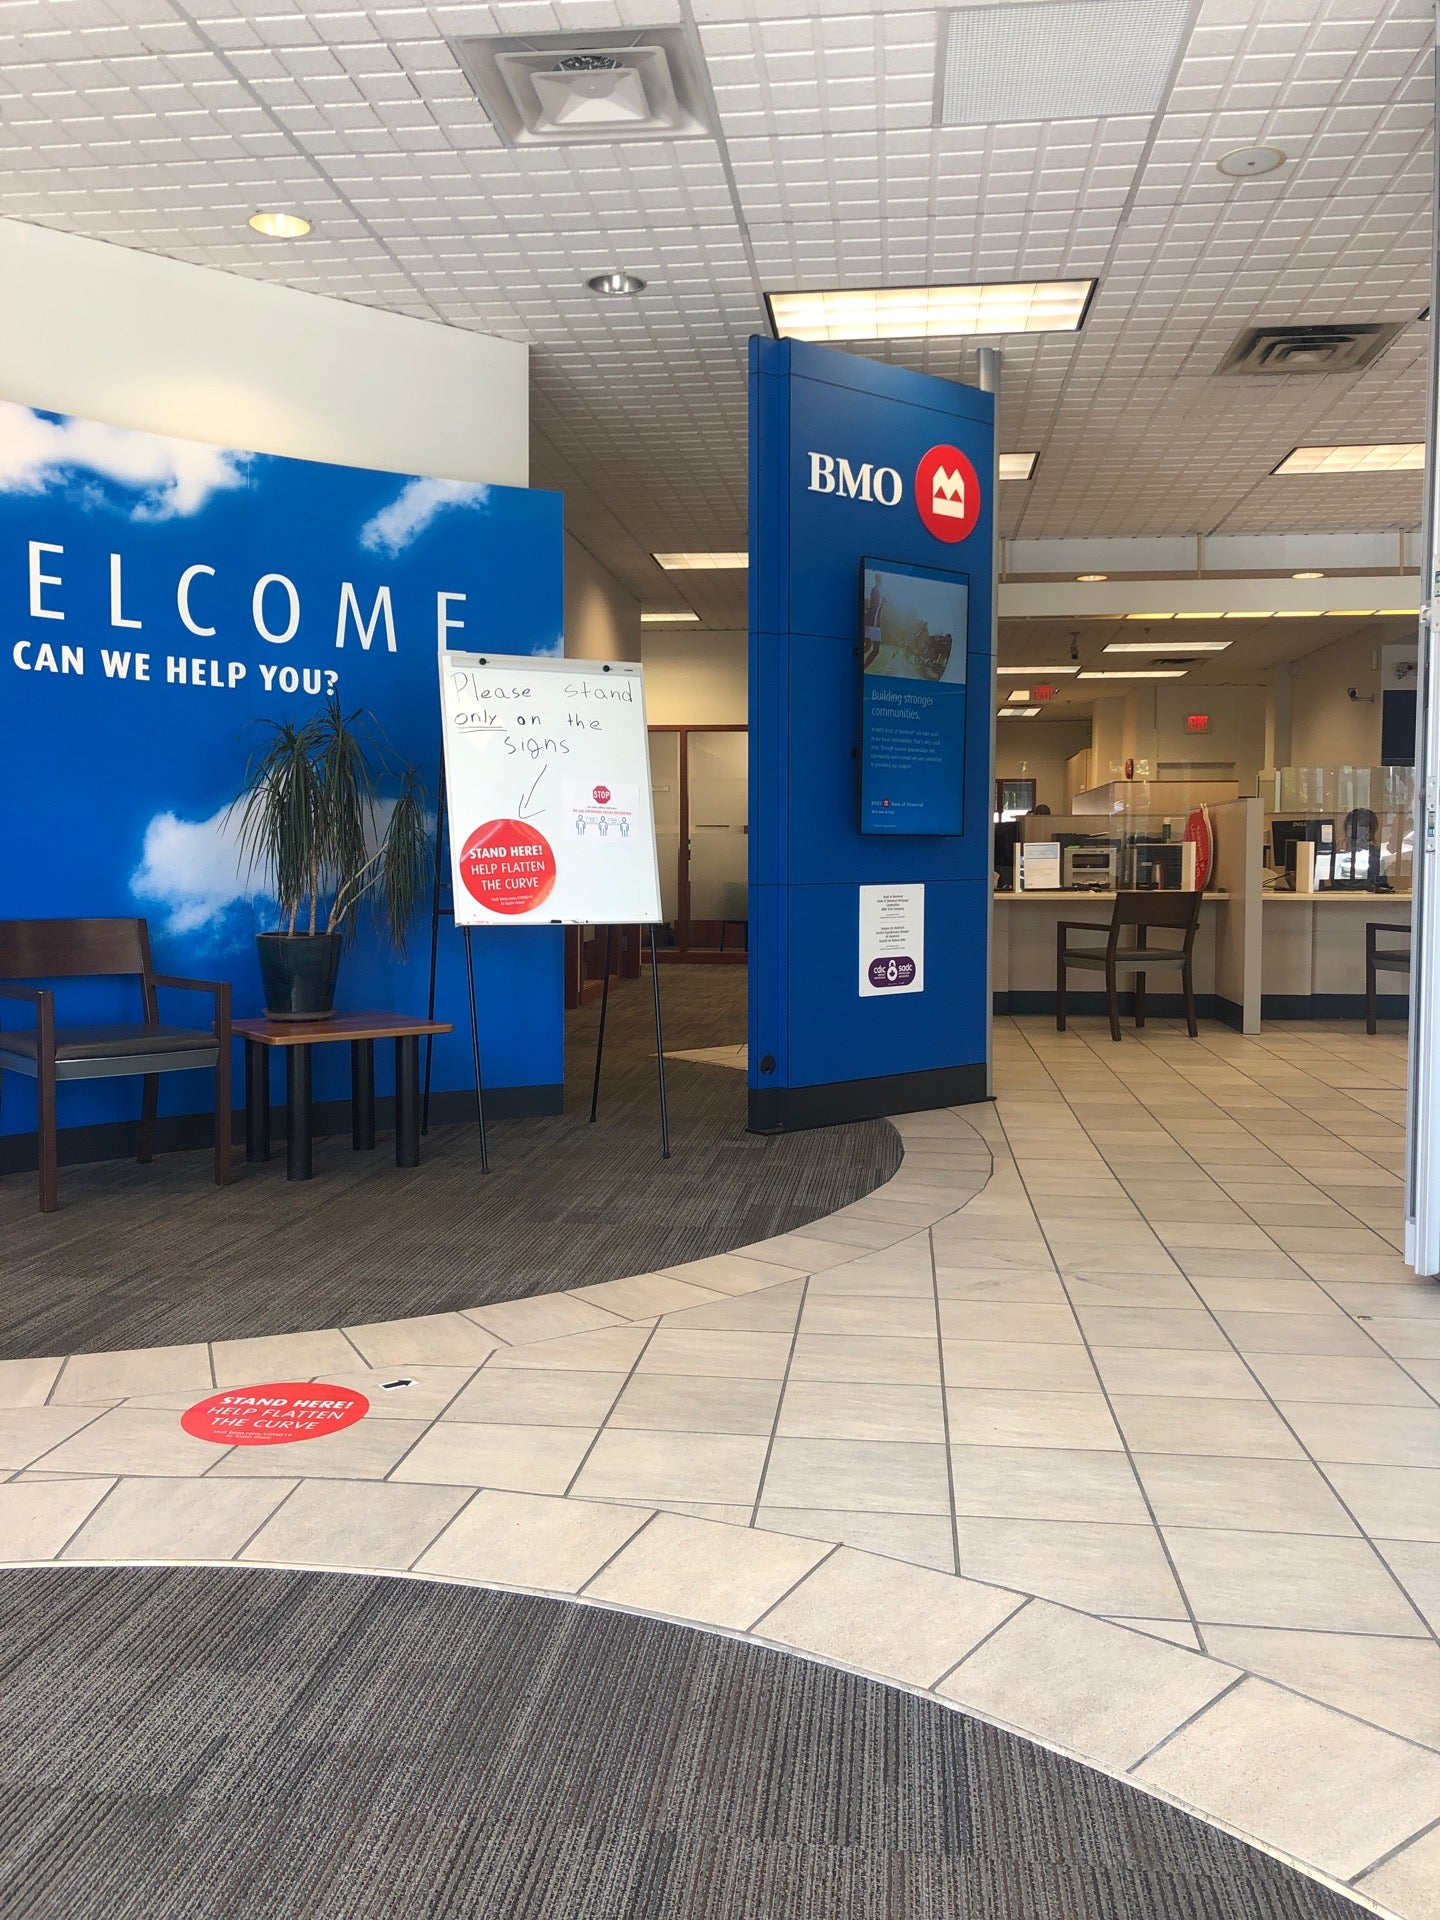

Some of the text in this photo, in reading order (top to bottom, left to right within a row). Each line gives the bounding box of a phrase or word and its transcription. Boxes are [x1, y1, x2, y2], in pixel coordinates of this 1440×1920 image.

[807, 451, 903, 506] BMO
[13, 640, 339, 696] CAN WE HELP YOU?
[450, 672, 532, 702] Please
[871, 690, 934, 708] Building stronger
[454, 709, 603, 731] only on the
[871, 707, 921, 720] communities.
[593, 790, 610, 799] STOP
[469, 845, 543, 860] STAND HERE!
[471, 860, 545, 875] HELP FLATTEN
[481, 876, 539, 891] THE CURVE
[220, 1396, 355, 1410] STAND HERE!
[207, 1406, 345, 1420] HELP FLATTEN
[210, 1417, 320, 1430] THE CURVE
